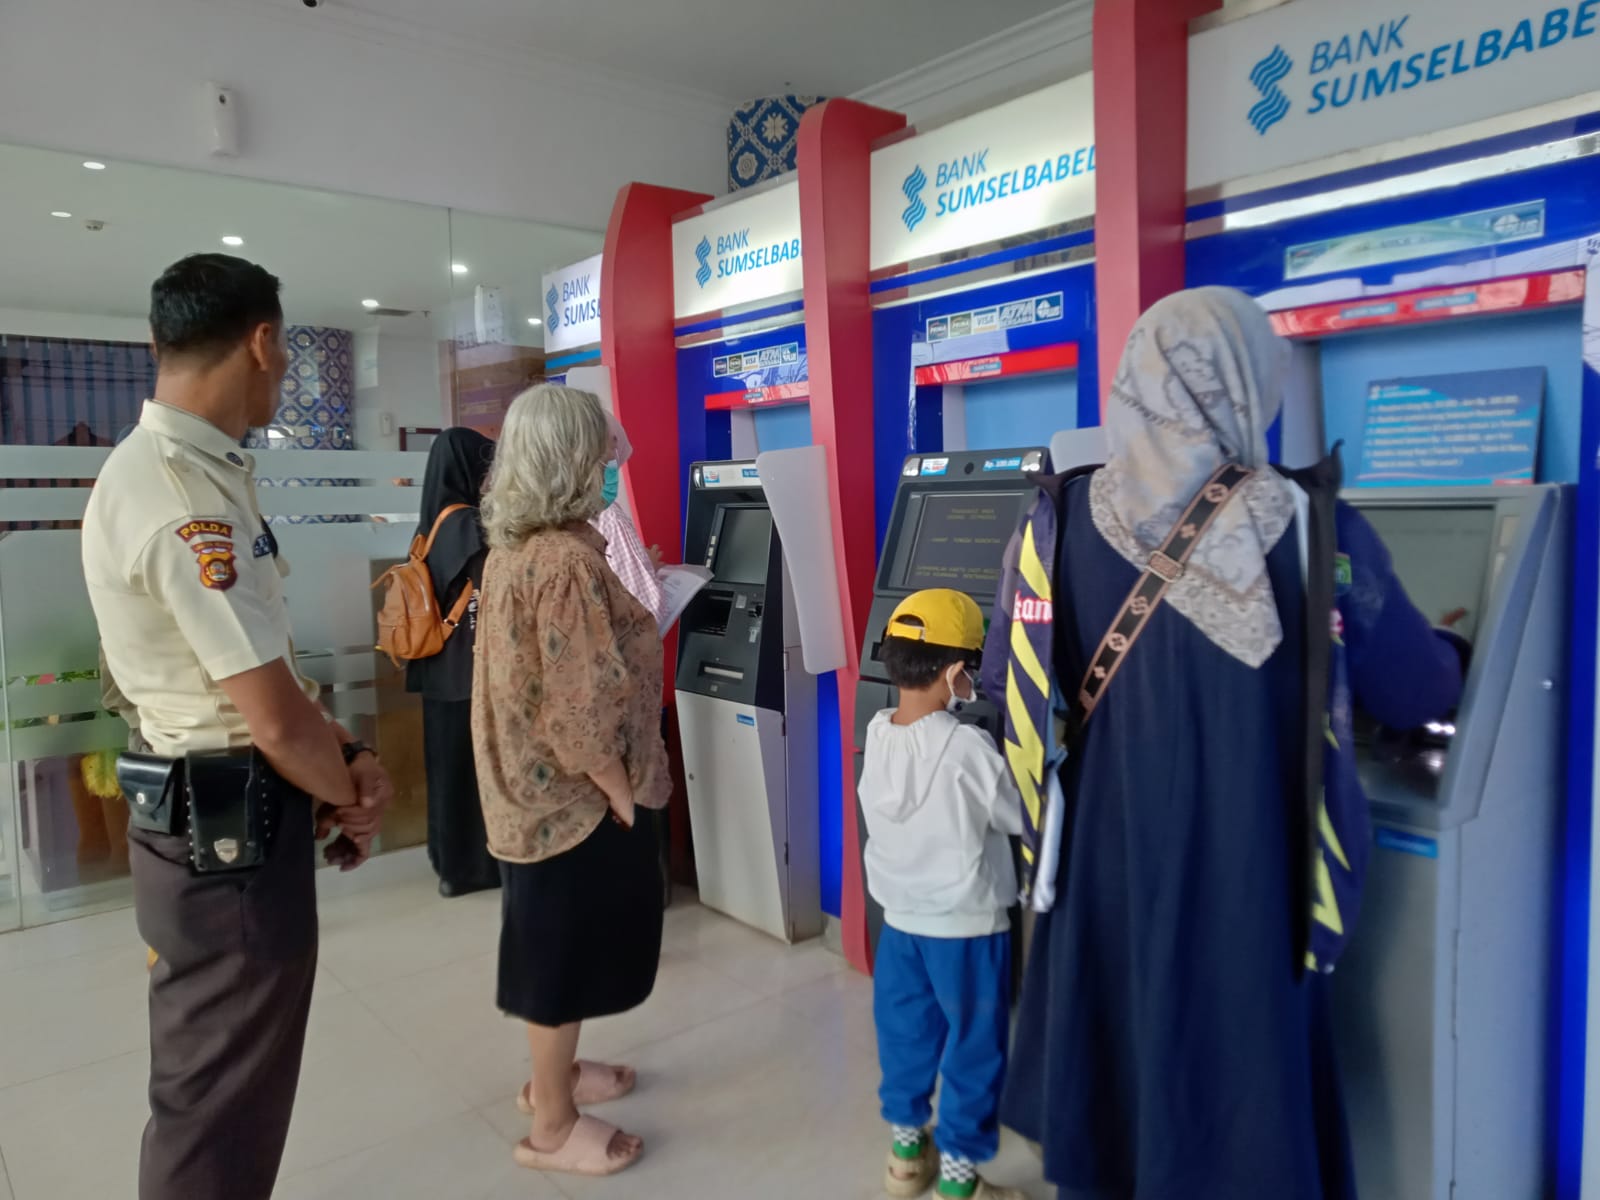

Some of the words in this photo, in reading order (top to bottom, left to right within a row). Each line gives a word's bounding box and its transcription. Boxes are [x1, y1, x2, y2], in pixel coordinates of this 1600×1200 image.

[1309, 15, 1409, 75] BANK
[935, 148, 989, 187] BANK
[716, 227, 750, 255] BANK
[716, 238, 800, 278] SUMSELBAB
[562, 273, 591, 302] BANK
[180, 522, 229, 538] POLDA
